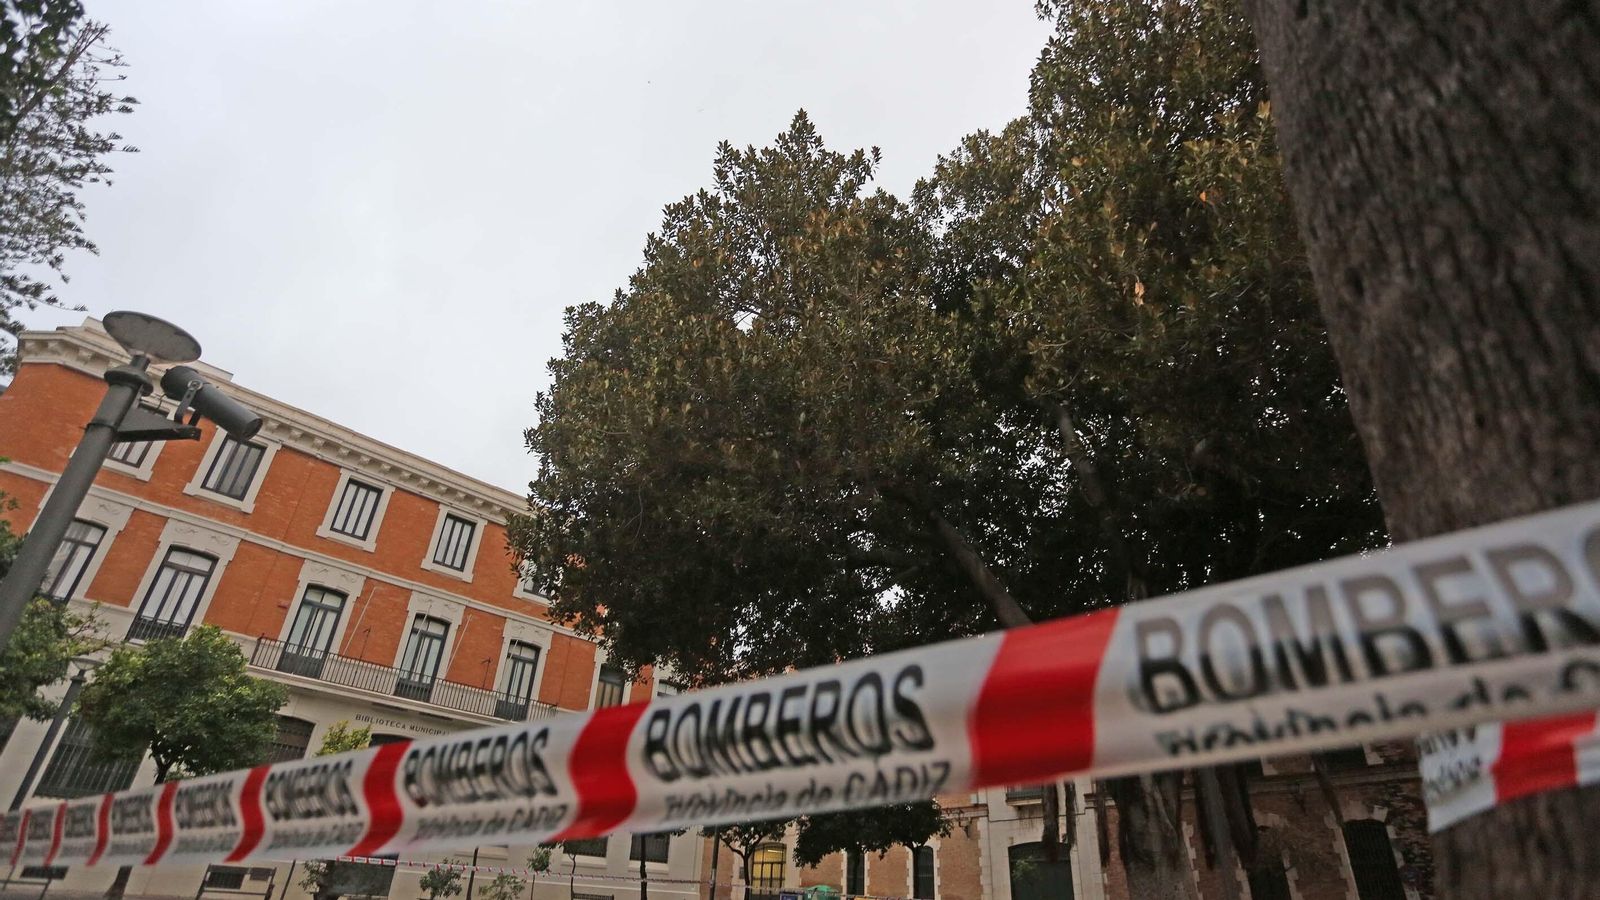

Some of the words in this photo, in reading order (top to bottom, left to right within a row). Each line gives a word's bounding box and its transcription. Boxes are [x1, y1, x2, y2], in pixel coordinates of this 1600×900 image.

[1128, 523, 1600, 715] BOMBER
[355, 713, 406, 730] BIBLIOTECA
[404, 726, 558, 808] BOMBEROS
[644, 664, 935, 782] BOMBEROS
